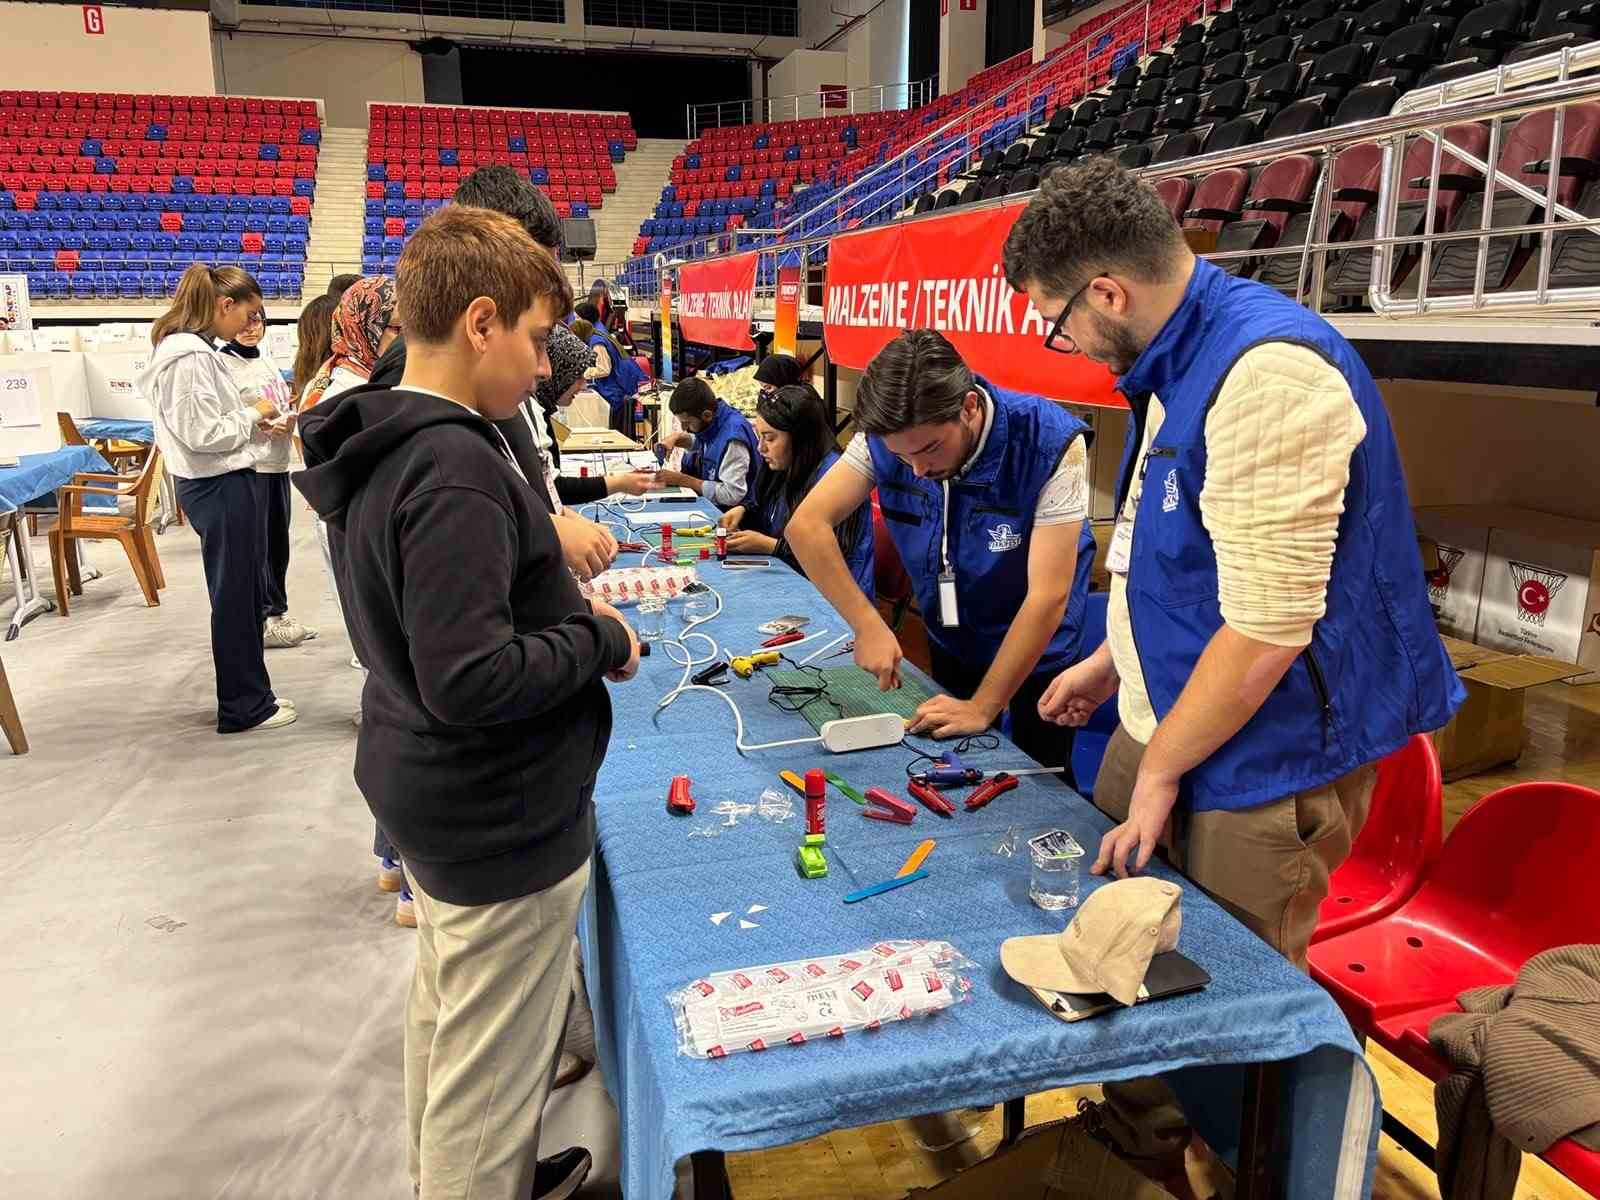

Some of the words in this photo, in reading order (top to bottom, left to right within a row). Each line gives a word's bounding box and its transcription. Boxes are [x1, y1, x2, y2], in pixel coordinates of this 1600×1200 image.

[86, 8, 101, 33] G
[825, 280, 909, 329] MALZEME
[5, 378, 28, 391] 239
